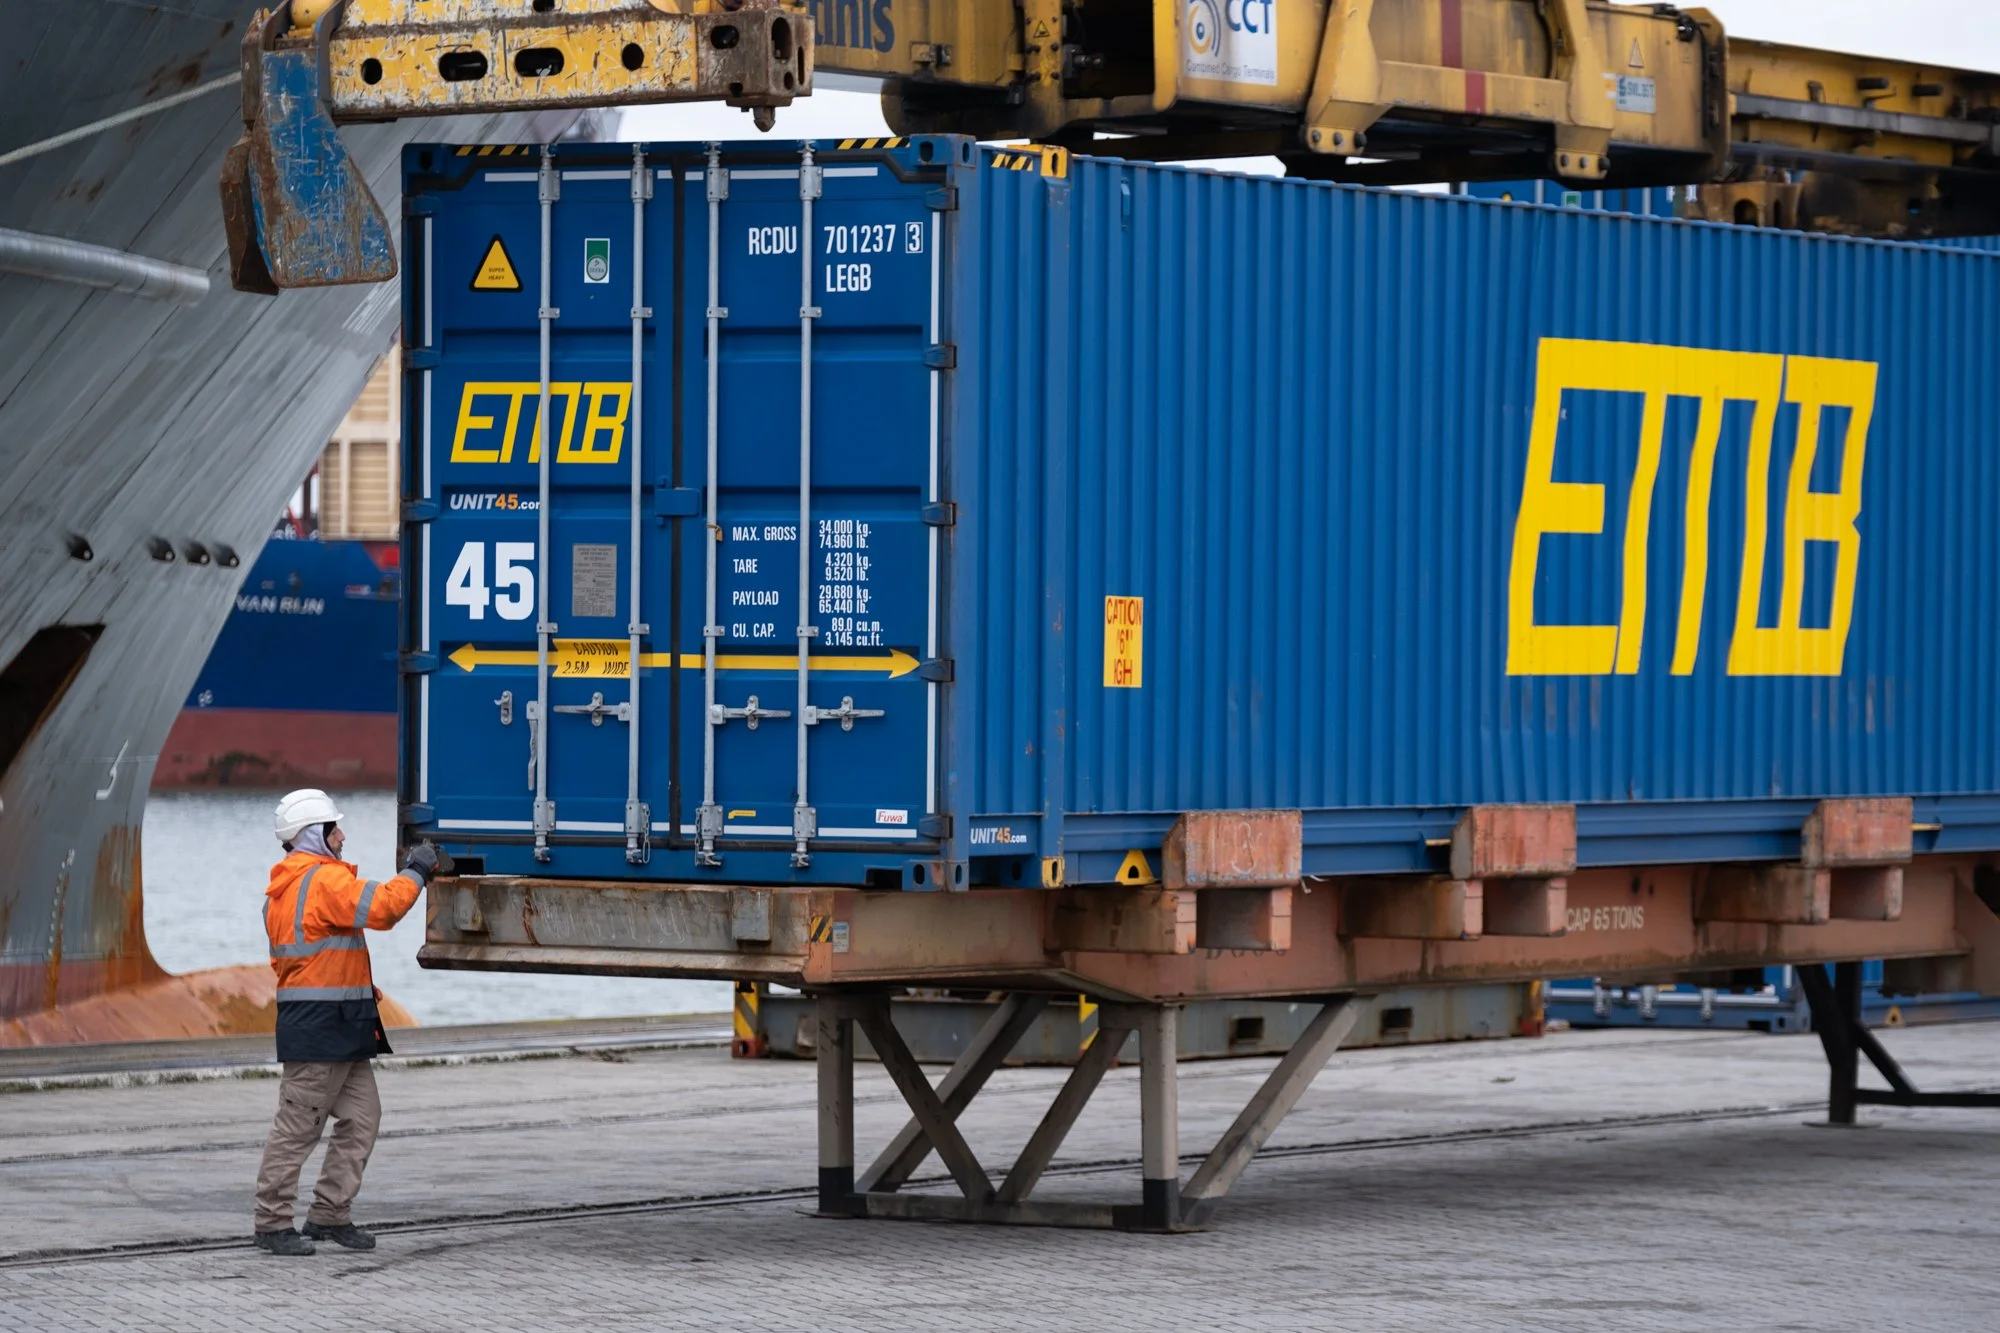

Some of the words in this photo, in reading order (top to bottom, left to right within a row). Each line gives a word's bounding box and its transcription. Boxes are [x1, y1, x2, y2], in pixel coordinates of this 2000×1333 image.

[1225, 0, 1272, 34] CCT
[748, 226, 797, 255] RCDU
[824, 224, 896, 254] 701237
[907, 223, 921, 252] 3
[825, 263, 872, 292] LEGB
[732, 527, 760, 541] MAX.
[764, 526, 797, 541] GROSS
[819, 520, 853, 534] 34.000
[856, 520, 872, 536] kg.
[819, 535, 853, 549] 74.960
[856, 535, 869, 549] lb.
[733, 559, 758, 573] TARE
[825, 552, 853, 567] 4.320
[856, 552, 872, 569] kg.
[445, 541, 535, 620] 45
[825, 567, 853, 581] 9.520
[856, 567, 869, 581] lb.
[732, 591, 779, 605] PAYLOAD
[819, 585, 853, 599] 29.680
[856, 585, 872, 602] kg.
[819, 600, 853, 614] 65.440
[856, 600, 869, 614] lb.
[732, 623, 749, 638] CU.
[753, 623, 776, 638] CAP.
[832, 617, 853, 632] 89.0
[856, 620, 884, 632] cu.m.
[825, 632, 853, 646] 3.145
[856, 632, 884, 646] cu.ft.
[573, 642, 619, 656] CAUTION
[562, 661, 590, 674] 2.5M
[602, 661, 629, 675] WIDE
[877, 811, 905, 823] Fuwa
[970, 827, 1027, 844] UNIT45.com
[1566, 908, 1592, 931] CAP
[1593, 907, 1610, 930] 65
[1612, 905, 1645, 929] TONS
